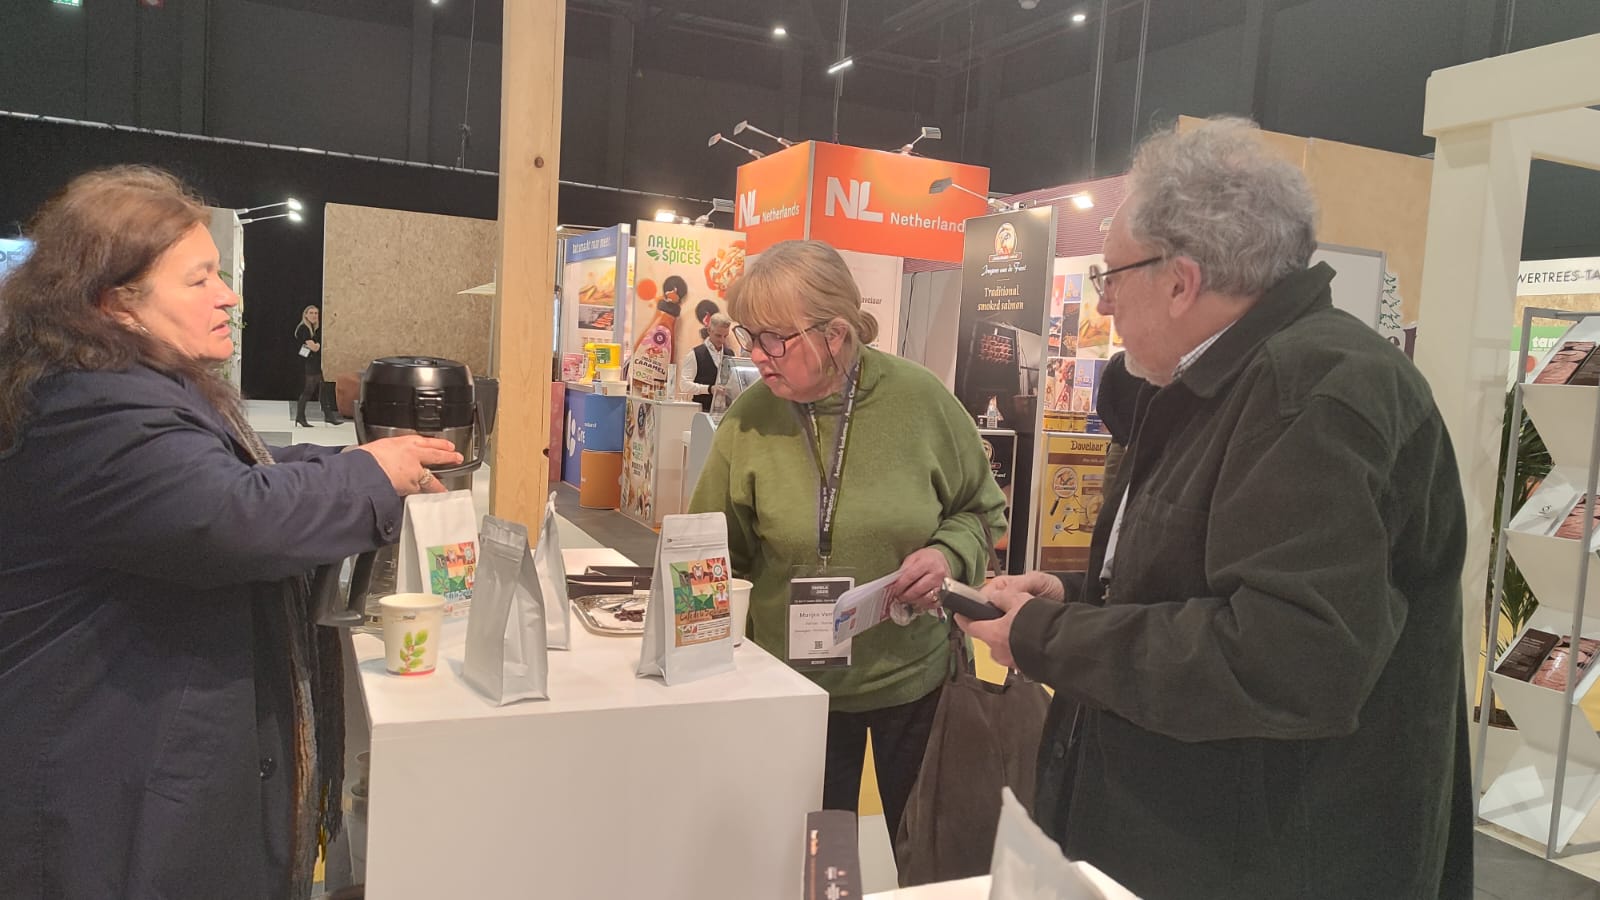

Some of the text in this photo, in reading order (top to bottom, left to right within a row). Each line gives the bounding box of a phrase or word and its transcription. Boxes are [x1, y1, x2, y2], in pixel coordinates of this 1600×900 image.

[738, 189, 800, 229] NL Netherlands
[825, 176, 965, 233] NL Netherland
[984, 284, 1020, 297] Traditional
[977, 299, 1024, 311] smoked salmon
[634, 358, 666, 375] CARAMEL
